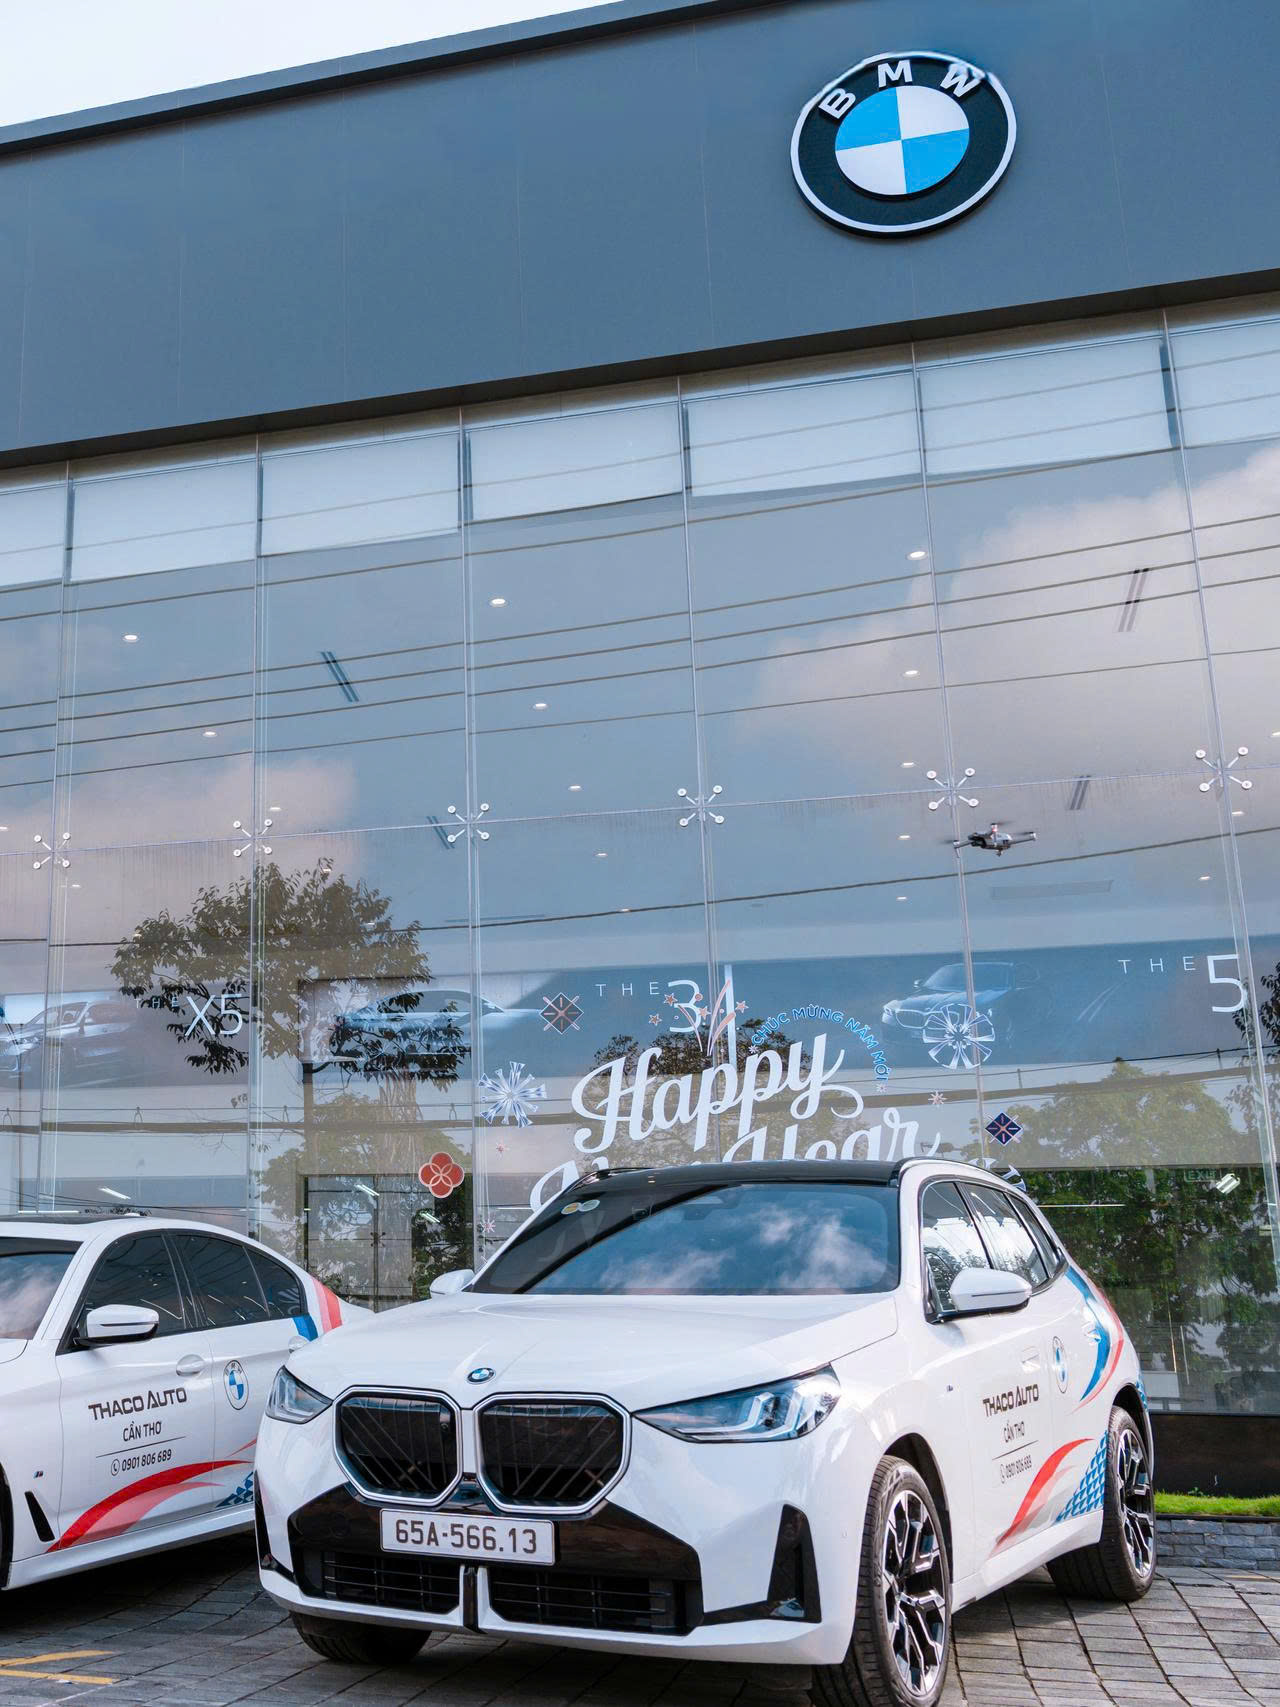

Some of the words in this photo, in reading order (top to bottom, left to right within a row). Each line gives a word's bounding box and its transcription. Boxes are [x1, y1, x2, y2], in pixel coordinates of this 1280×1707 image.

[818, 59, 984, 119] BMW
[1118, 956, 1196, 974] THE
[1207, 954, 1248, 1012] 5
[134, 995, 180, 1009] THE
[184, 993, 243, 1036] X5
[595, 982, 660, 997] THE
[668, 979, 702, 1033] 3
[751, 1012, 790, 1045] CHÚC
[792, 1003, 844, 1023] MỪNG
[845, 1018, 879, 1049] NĂM
[572, 1033, 864, 1154] Happy
[88, 1395, 145, 1421] THACO
[147, 1387, 188, 1410] AUTO
[983, 1391, 1014, 1418] THACO
[1015, 1384, 1039, 1408] AUTO
[123, 1421, 142, 1442] CẦN
[143, 1421, 163, 1437] THƠ
[121, 1457, 140, 1472] 0901
[141, 1453, 156, 1467] 806
[157, 1449, 172, 1463] 689
[395, 1519, 537, 1554] 65A-566.13
